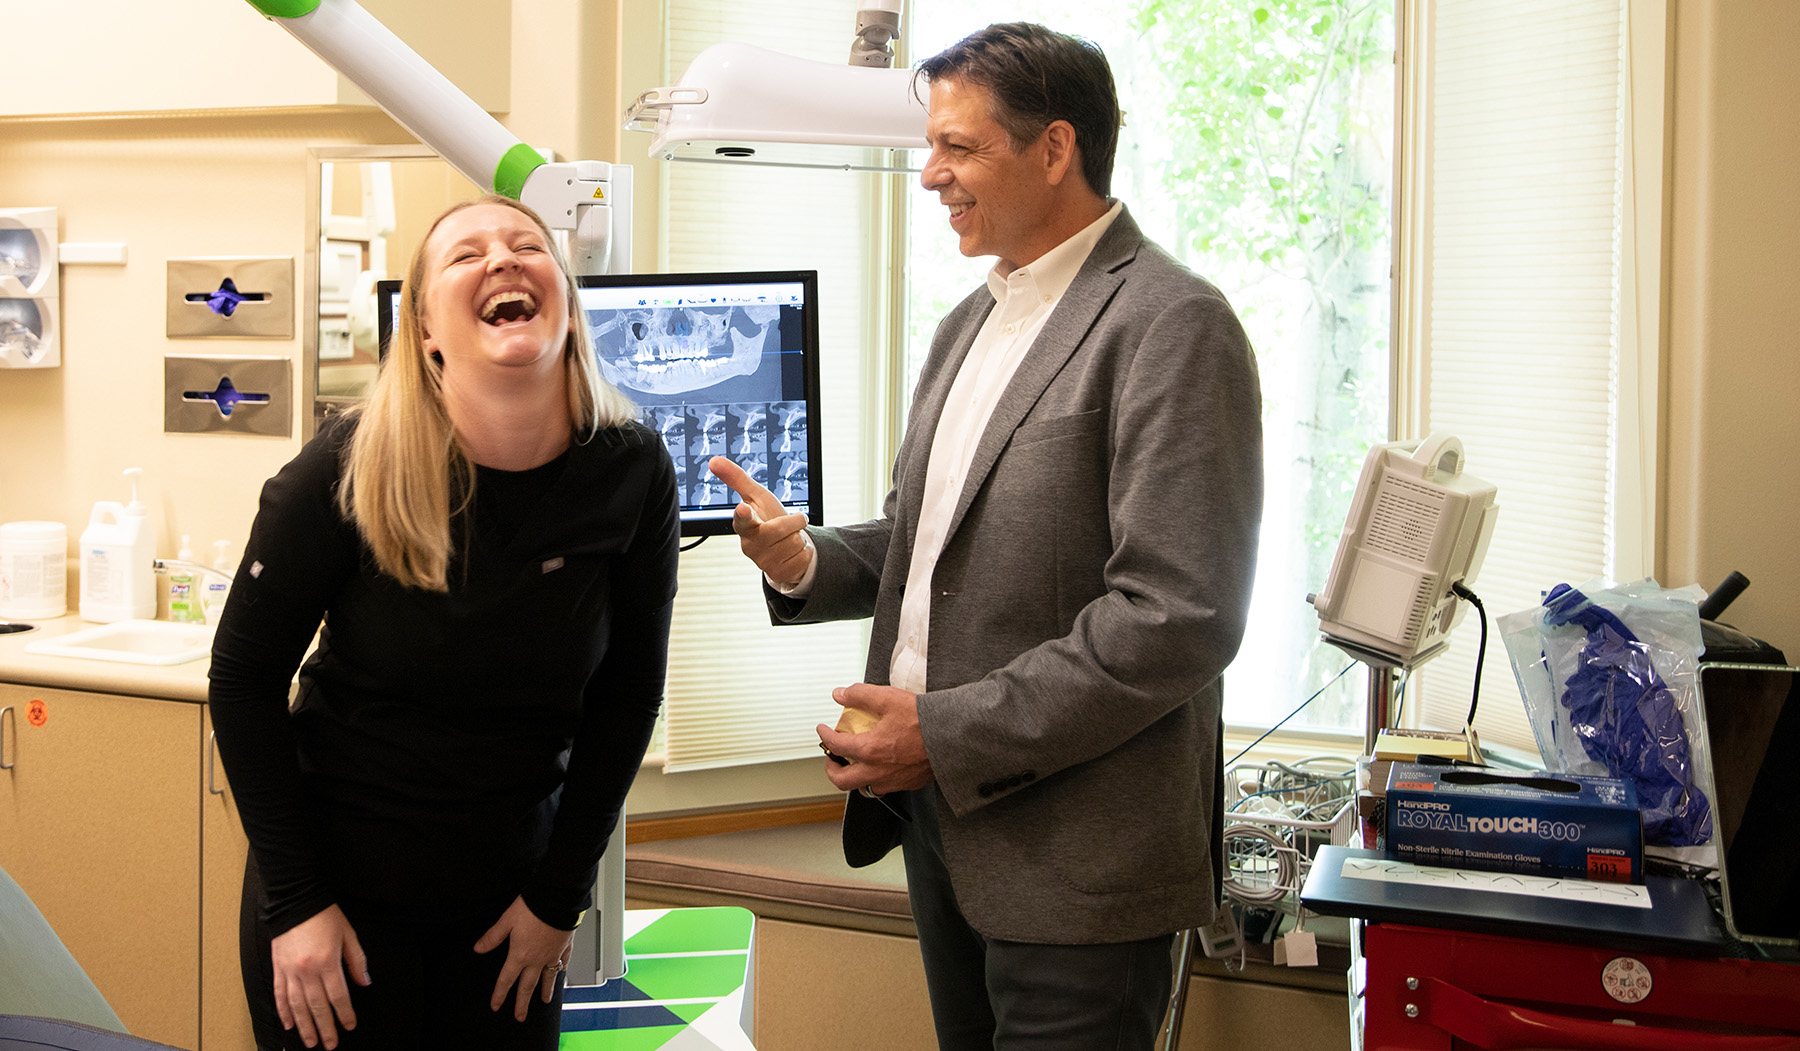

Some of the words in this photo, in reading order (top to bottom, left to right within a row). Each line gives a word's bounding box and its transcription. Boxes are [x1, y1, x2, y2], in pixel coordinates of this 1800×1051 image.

[1397, 800, 1451, 811] HandPRO
[1397, 843, 1439, 854] Non-Sterile
[1441, 847, 1464, 857] Nitrile
[1465, 850, 1512, 861] Examination
[1514, 853, 1541, 863] Gloves
